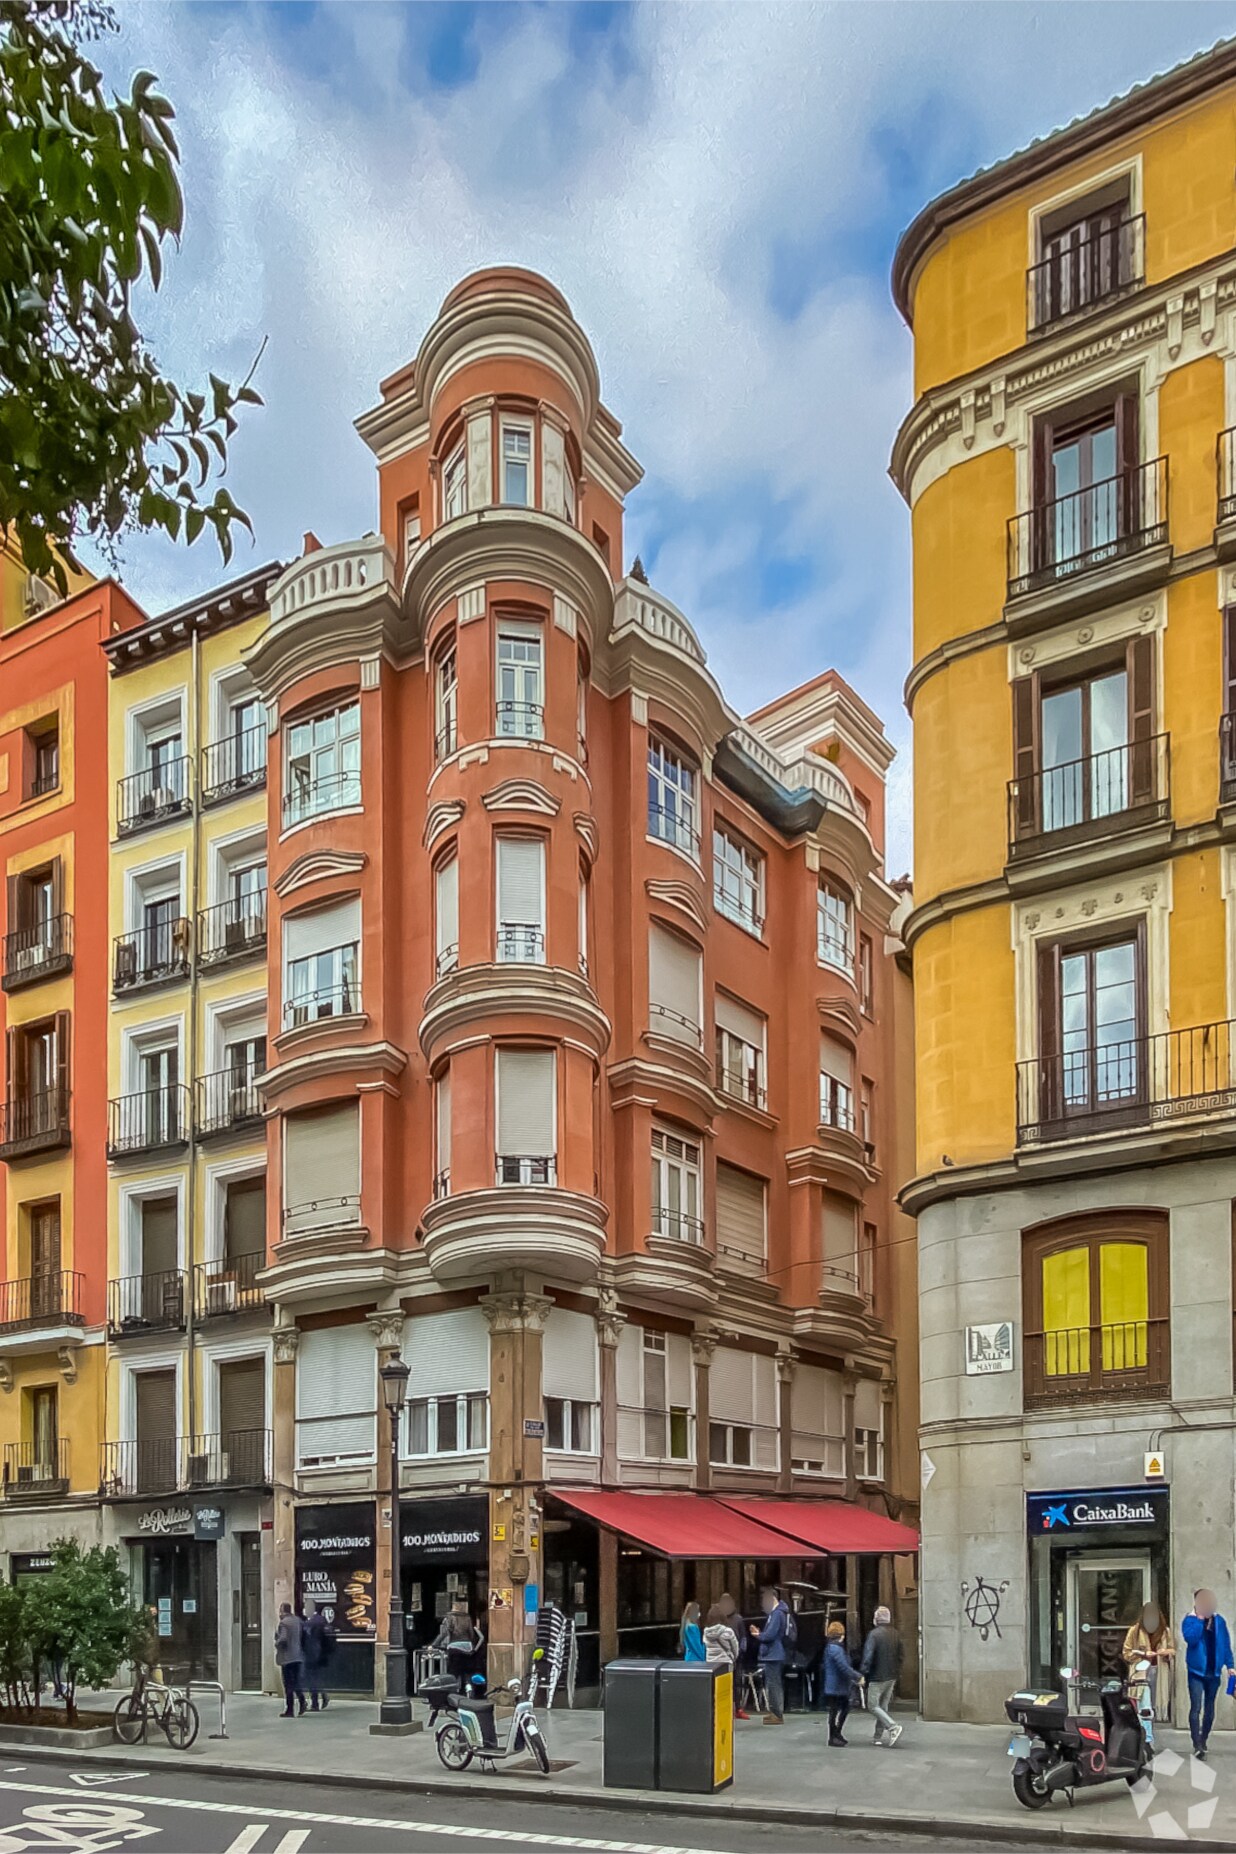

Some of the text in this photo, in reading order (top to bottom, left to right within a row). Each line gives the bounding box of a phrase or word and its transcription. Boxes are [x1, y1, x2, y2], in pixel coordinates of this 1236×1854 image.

[977, 1361, 1002, 1372] MAYOR
[1073, 1502, 1155, 1521] CaixaBank
[300, 1540, 318, 1550] 100
[402, 1535, 421, 1546] 100
[302, 1571, 328, 1582] EURO
